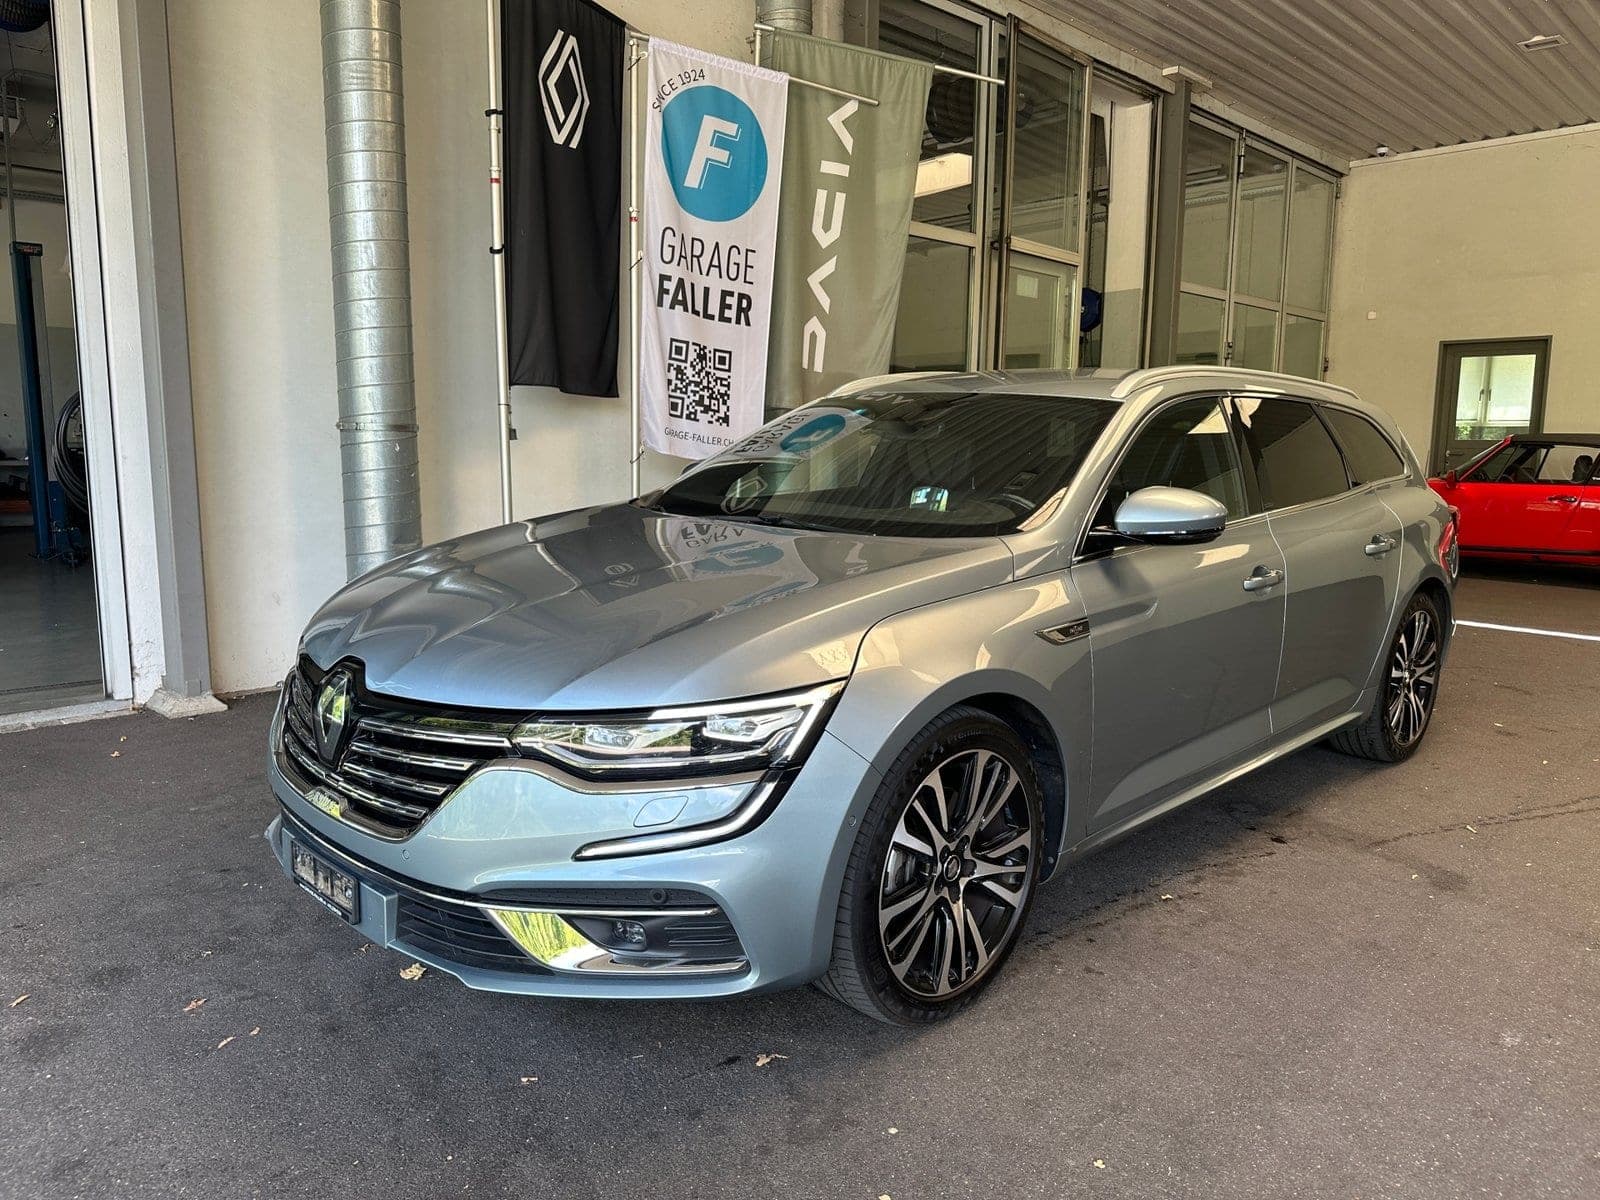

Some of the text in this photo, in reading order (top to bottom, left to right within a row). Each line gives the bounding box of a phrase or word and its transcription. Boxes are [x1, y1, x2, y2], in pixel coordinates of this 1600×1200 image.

[678, 68, 706, 86] 1924
[683, 114, 742, 190] F
[660, 226, 756, 285] GARAGE
[657, 273, 752, 327] FALLER
[664, 426, 735, 448] GRAGE-FALLER.CH
